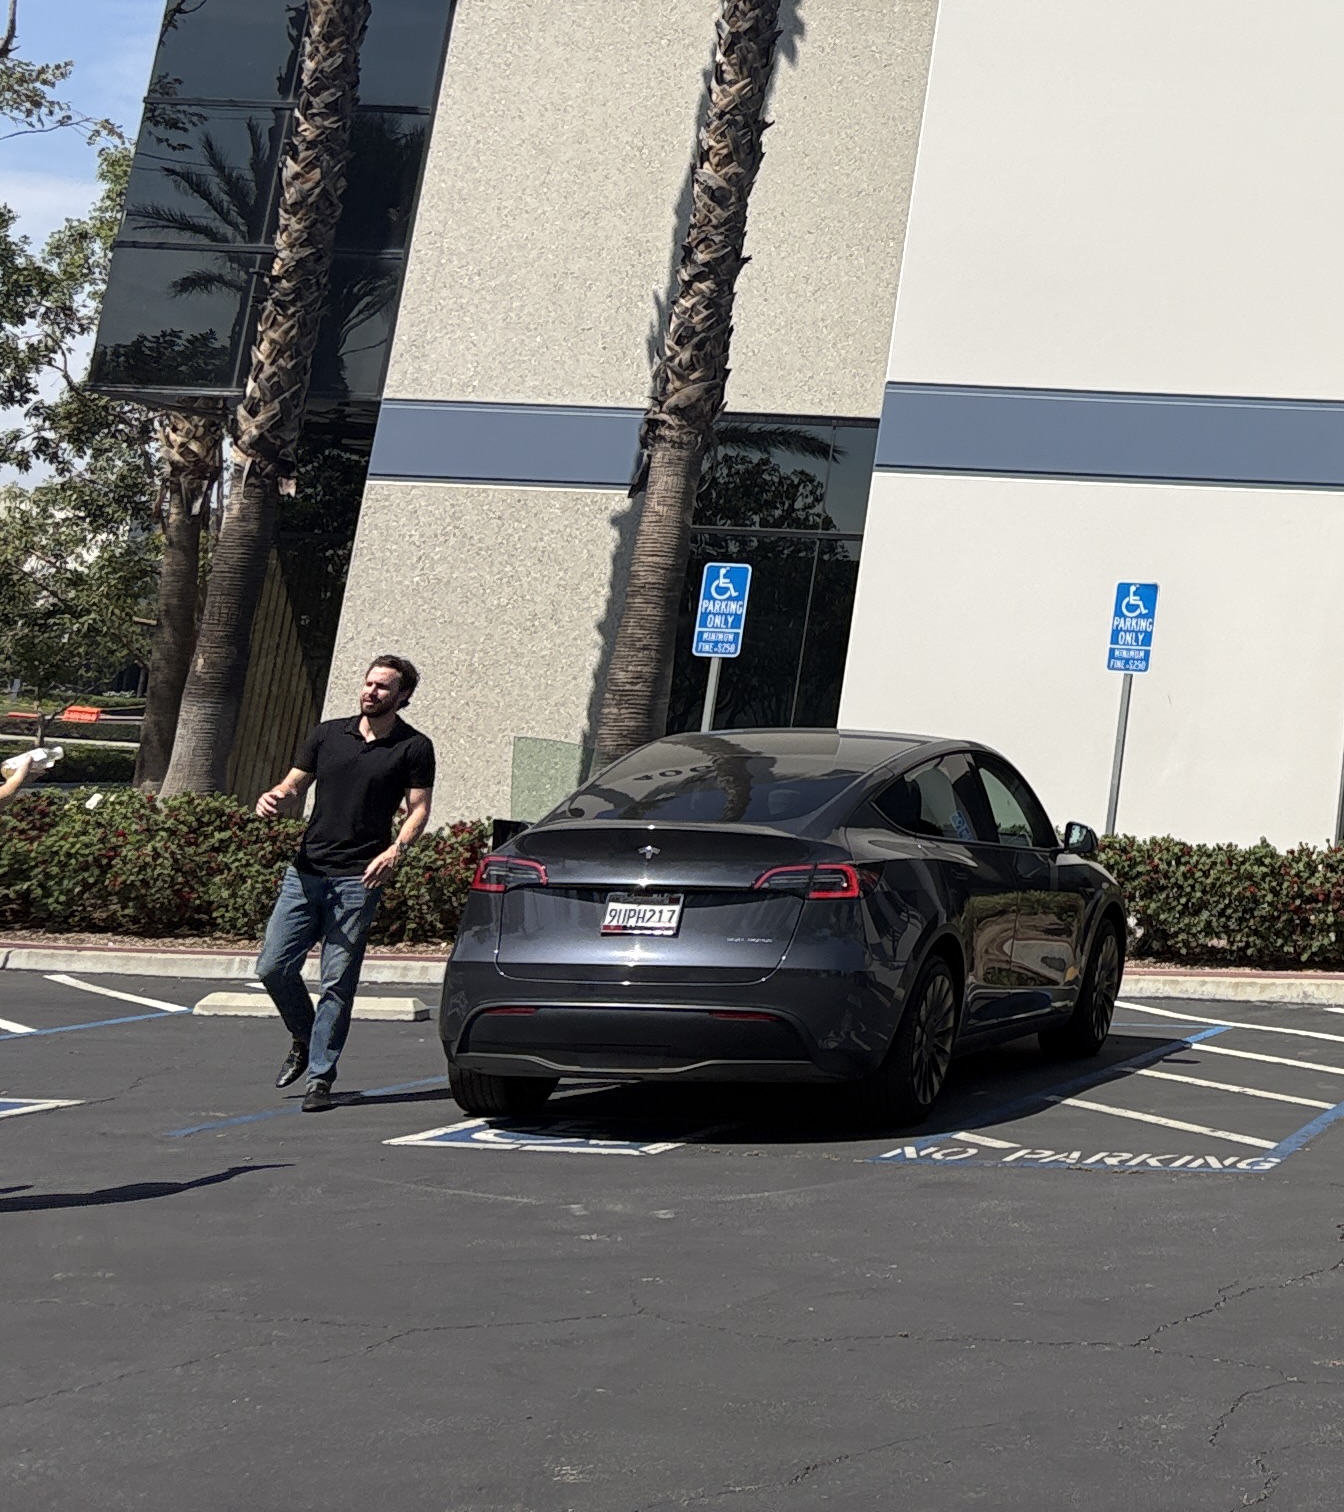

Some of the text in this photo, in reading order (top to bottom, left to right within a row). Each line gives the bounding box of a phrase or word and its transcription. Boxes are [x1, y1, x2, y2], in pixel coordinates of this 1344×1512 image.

[701, 600, 744, 615] PARKING
[706, 614, 735, 628] ONLY
[1113, 617, 1153, 632] PARKING
[1118, 632, 1145, 645] ONLY
[878, 1145, 1282, 1170] NO PARKING
